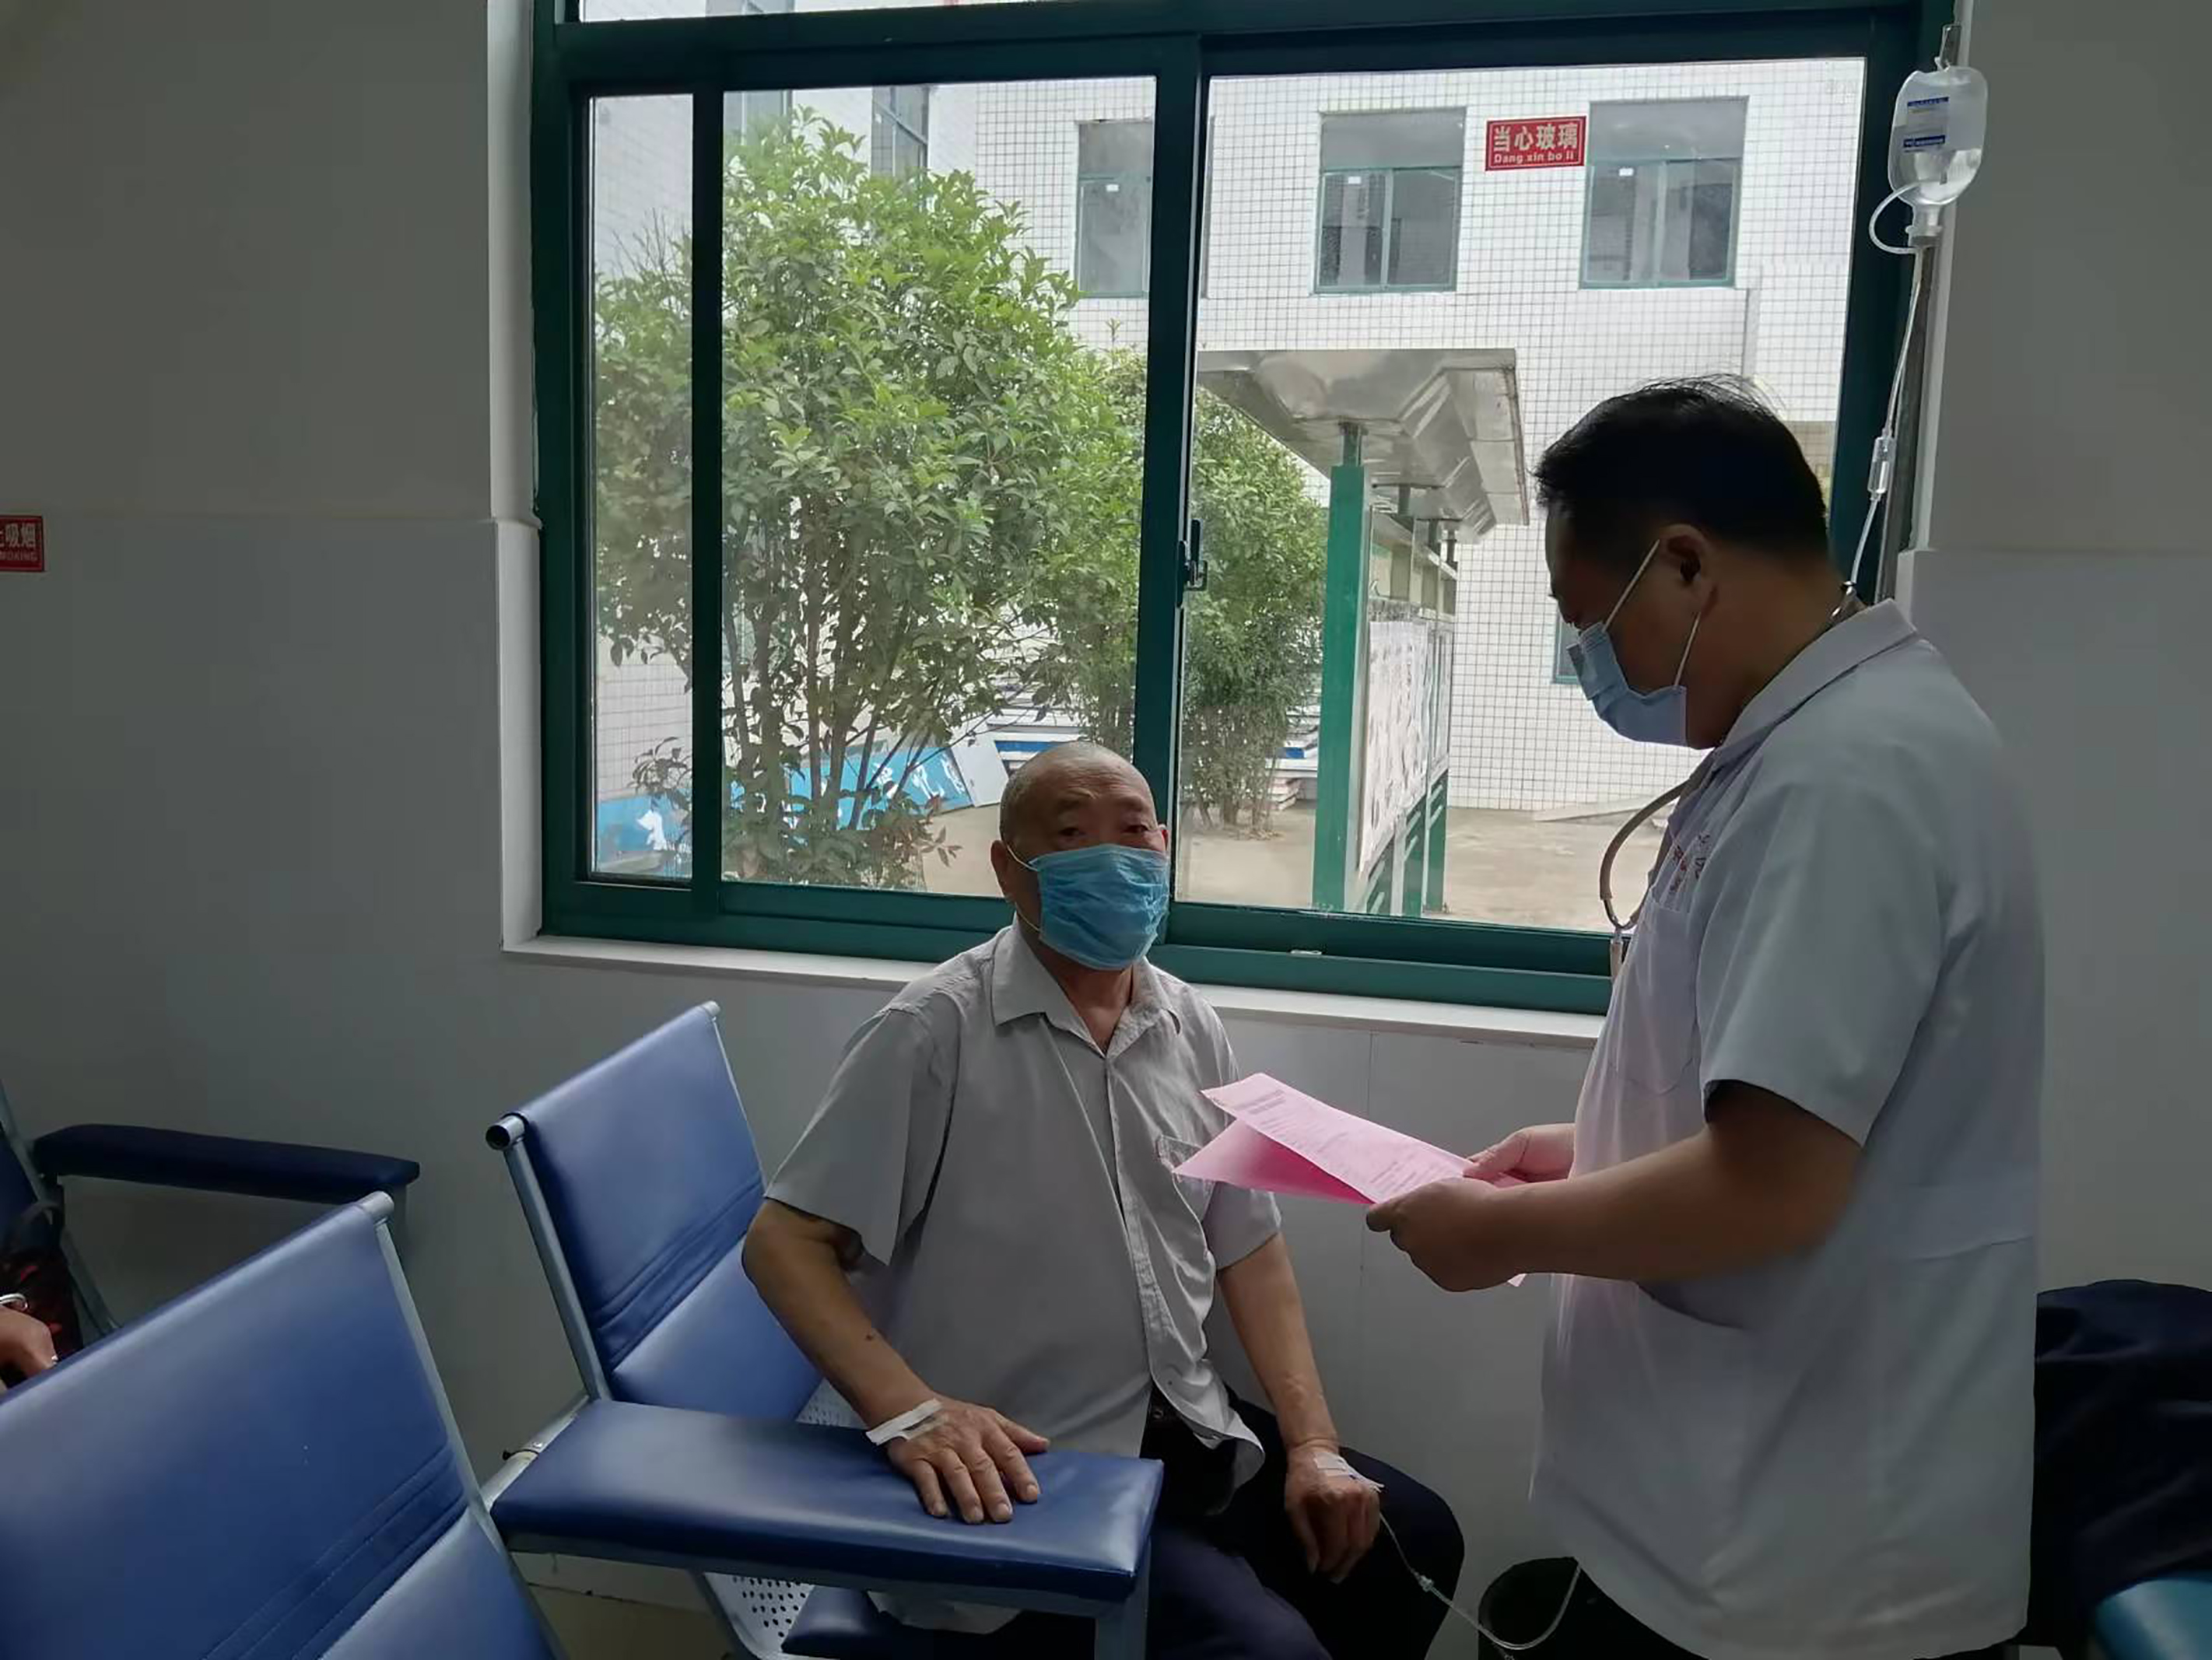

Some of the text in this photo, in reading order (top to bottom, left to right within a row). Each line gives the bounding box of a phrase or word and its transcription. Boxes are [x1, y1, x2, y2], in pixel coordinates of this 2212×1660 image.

[1493, 122, 1578, 152] 当心玻璃
[1493, 153, 1523, 164] Dang
[1527, 152, 1544, 162] xin
[1548, 151, 1562, 161] bo
